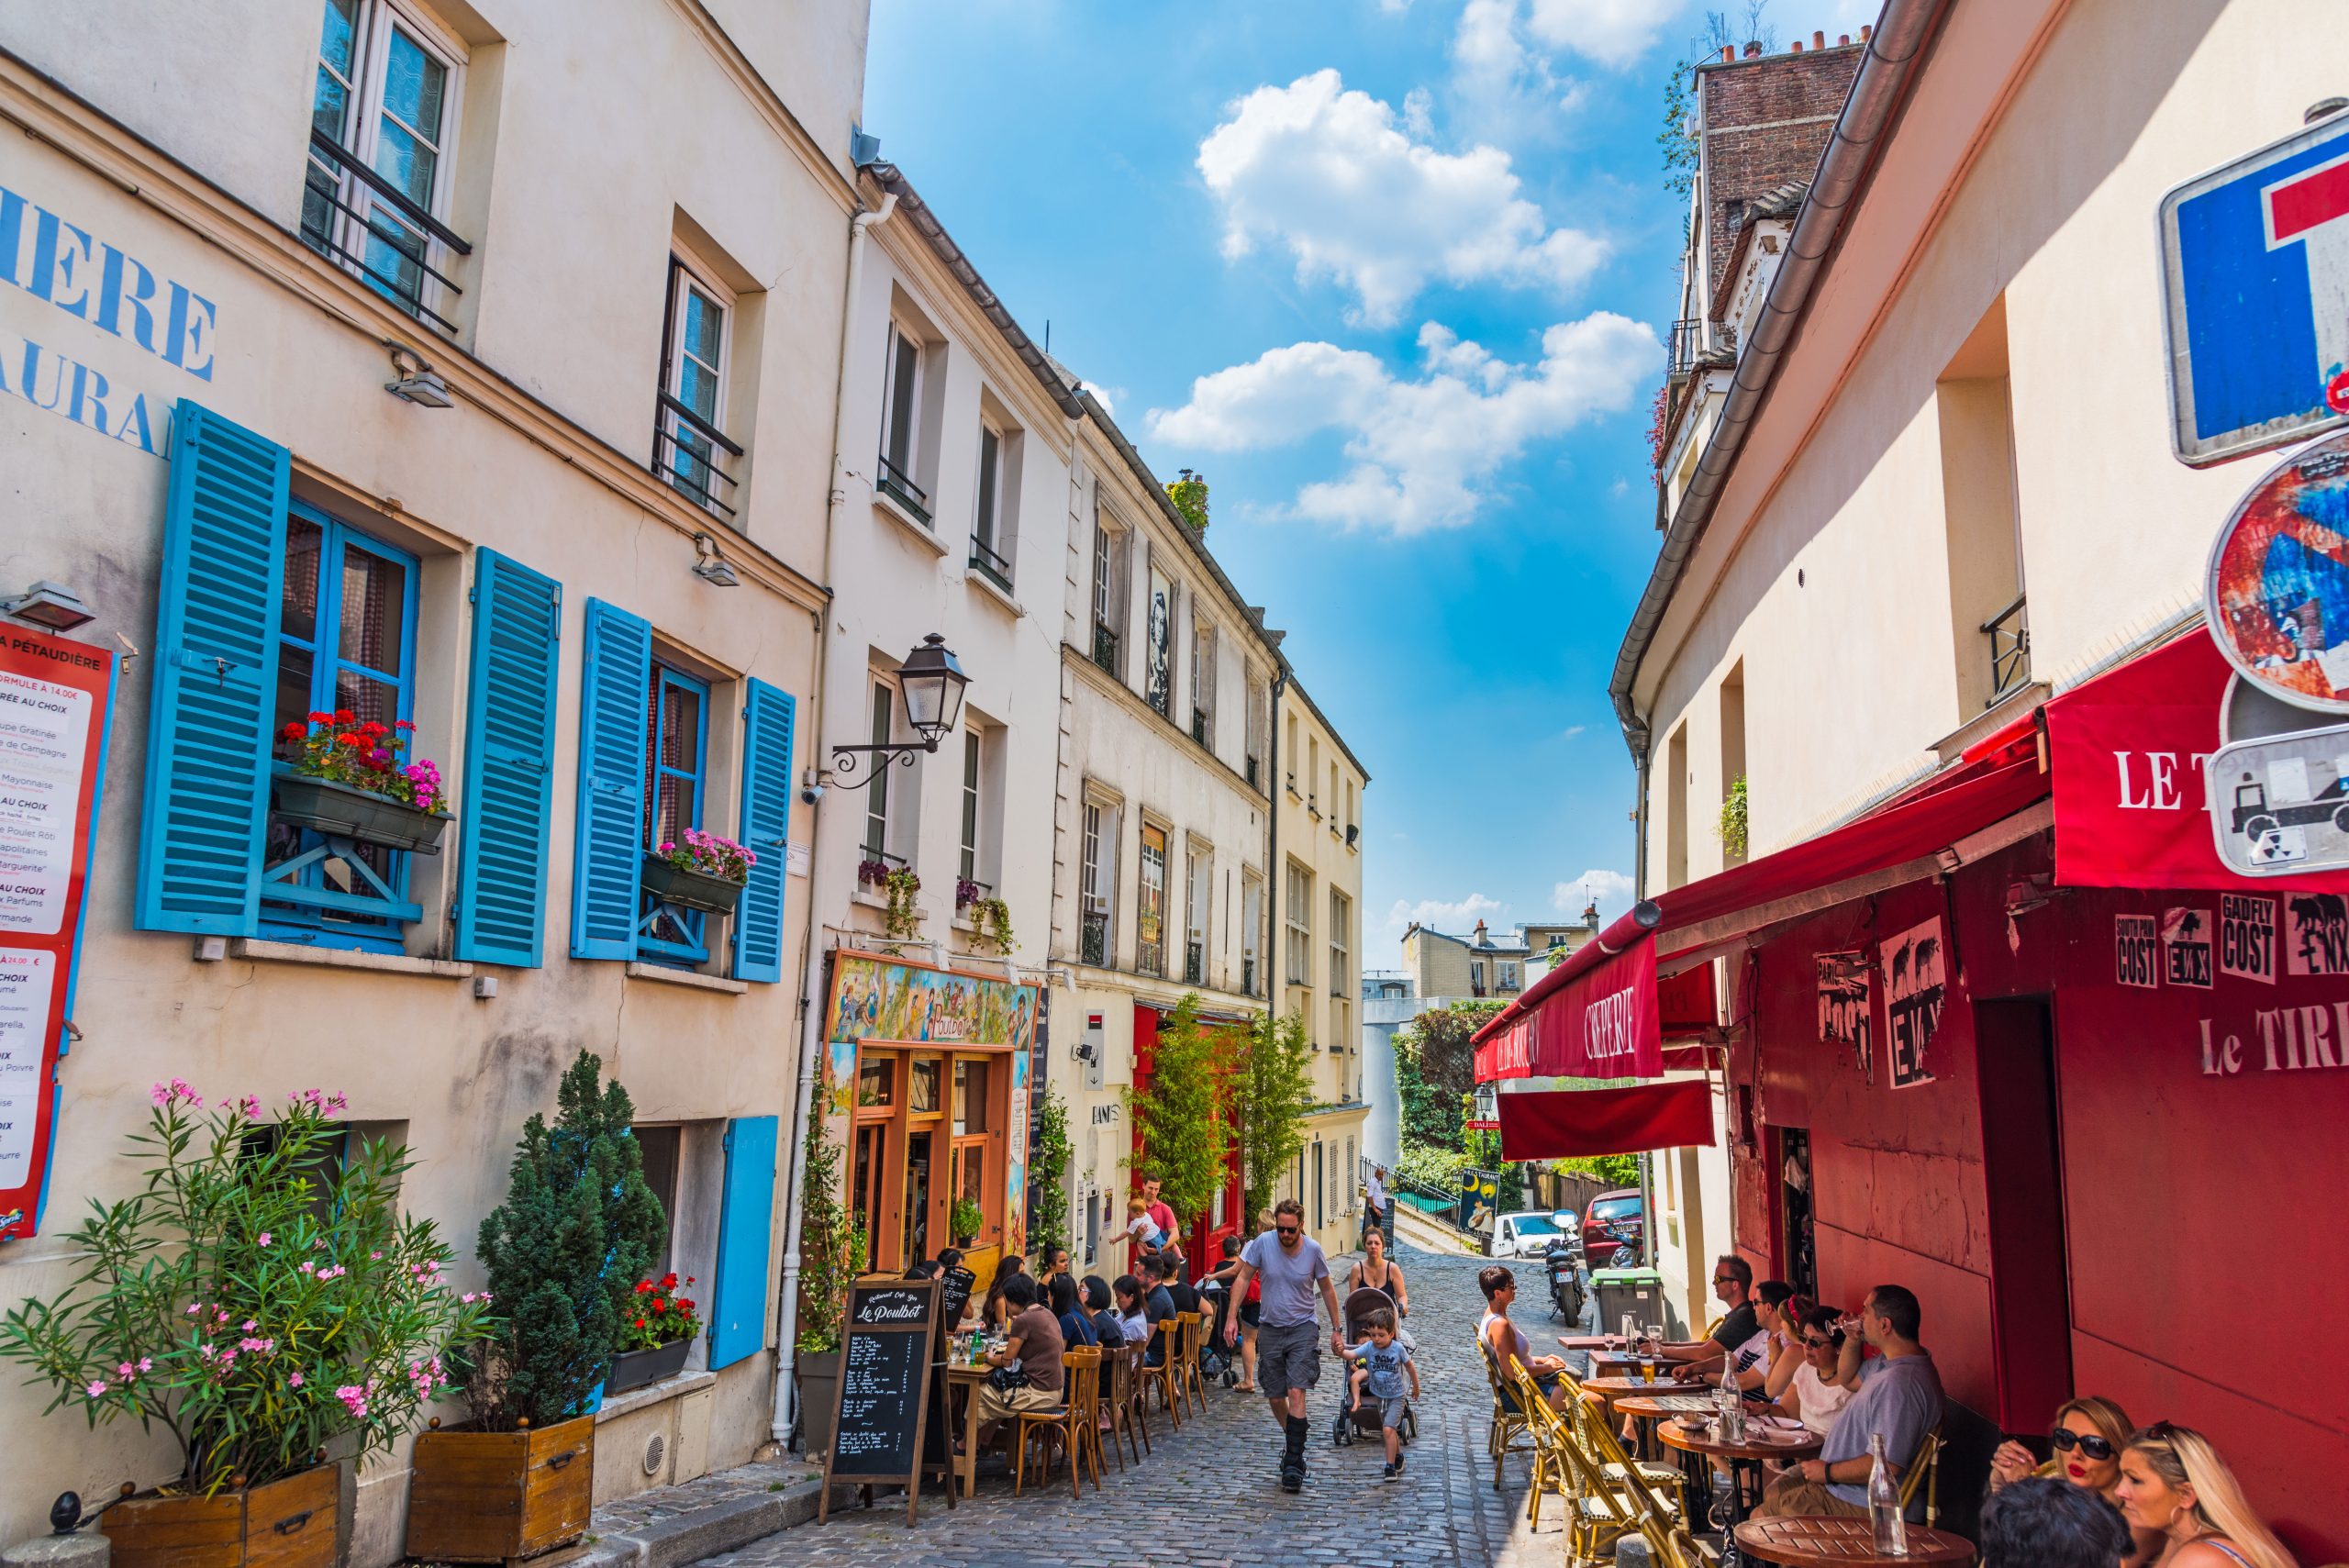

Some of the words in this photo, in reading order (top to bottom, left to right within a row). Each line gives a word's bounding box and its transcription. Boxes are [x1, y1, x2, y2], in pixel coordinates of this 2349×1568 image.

[12, 639, 101, 671] PÉTAUDIÈRE
[21, 697, 36, 706] AU
[38, 701, 68, 714] CHOIX
[19, 725, 57, 740] Gratinée
[20, 742, 67, 759] Campagne
[2, 773, 54, 790] Mayonnaise
[2113, 751, 2182, 809] LE
[1, 796, 16, 806] AU
[17, 799, 49, 811] CHOIX
[7, 826, 36, 838] Poulet
[15, 886, 47, 896] CHOIX
[6, 896, 44, 907] Parfums
[2222, 895, 2275, 924] GADFLY
[2222, 918, 2276, 976] COST
[2117, 937, 2156, 985] COST
[2199, 1018, 2243, 1077] Le
[6, 1063, 34, 1073] Poivre
[857, 1306, 873, 1322] Le
[874, 1304, 925, 1322] Poulbot
[1375, 1354, 1396, 1364] PAW
